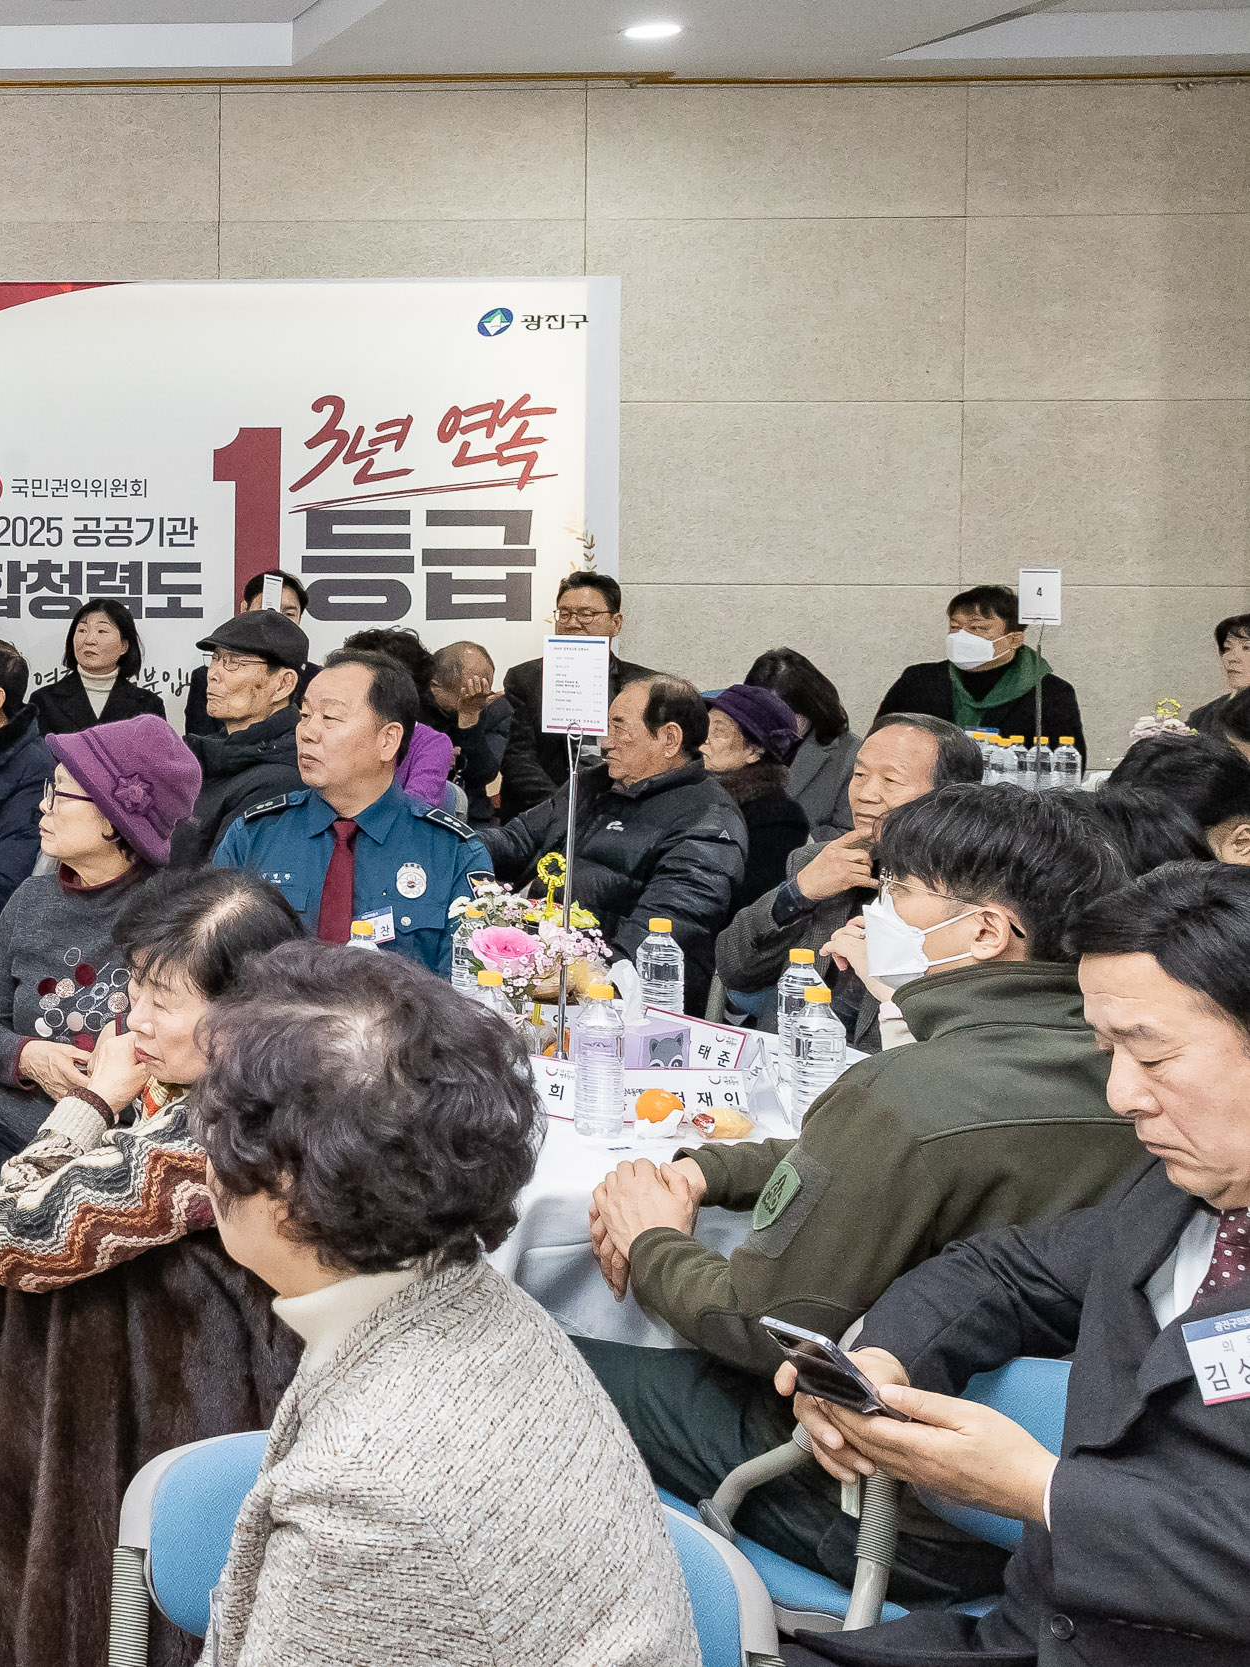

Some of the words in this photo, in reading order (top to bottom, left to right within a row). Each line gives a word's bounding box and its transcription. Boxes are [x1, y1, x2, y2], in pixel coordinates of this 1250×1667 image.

[521, 314, 589, 331] 광진구
[288, 395, 416, 493] 3년
[437, 393, 557, 492] 연속
[11, 478, 148, 499] 국민권익위원회
[72, 516, 199, 548] 공공기관
[1036, 587, 1043, 597] 4
